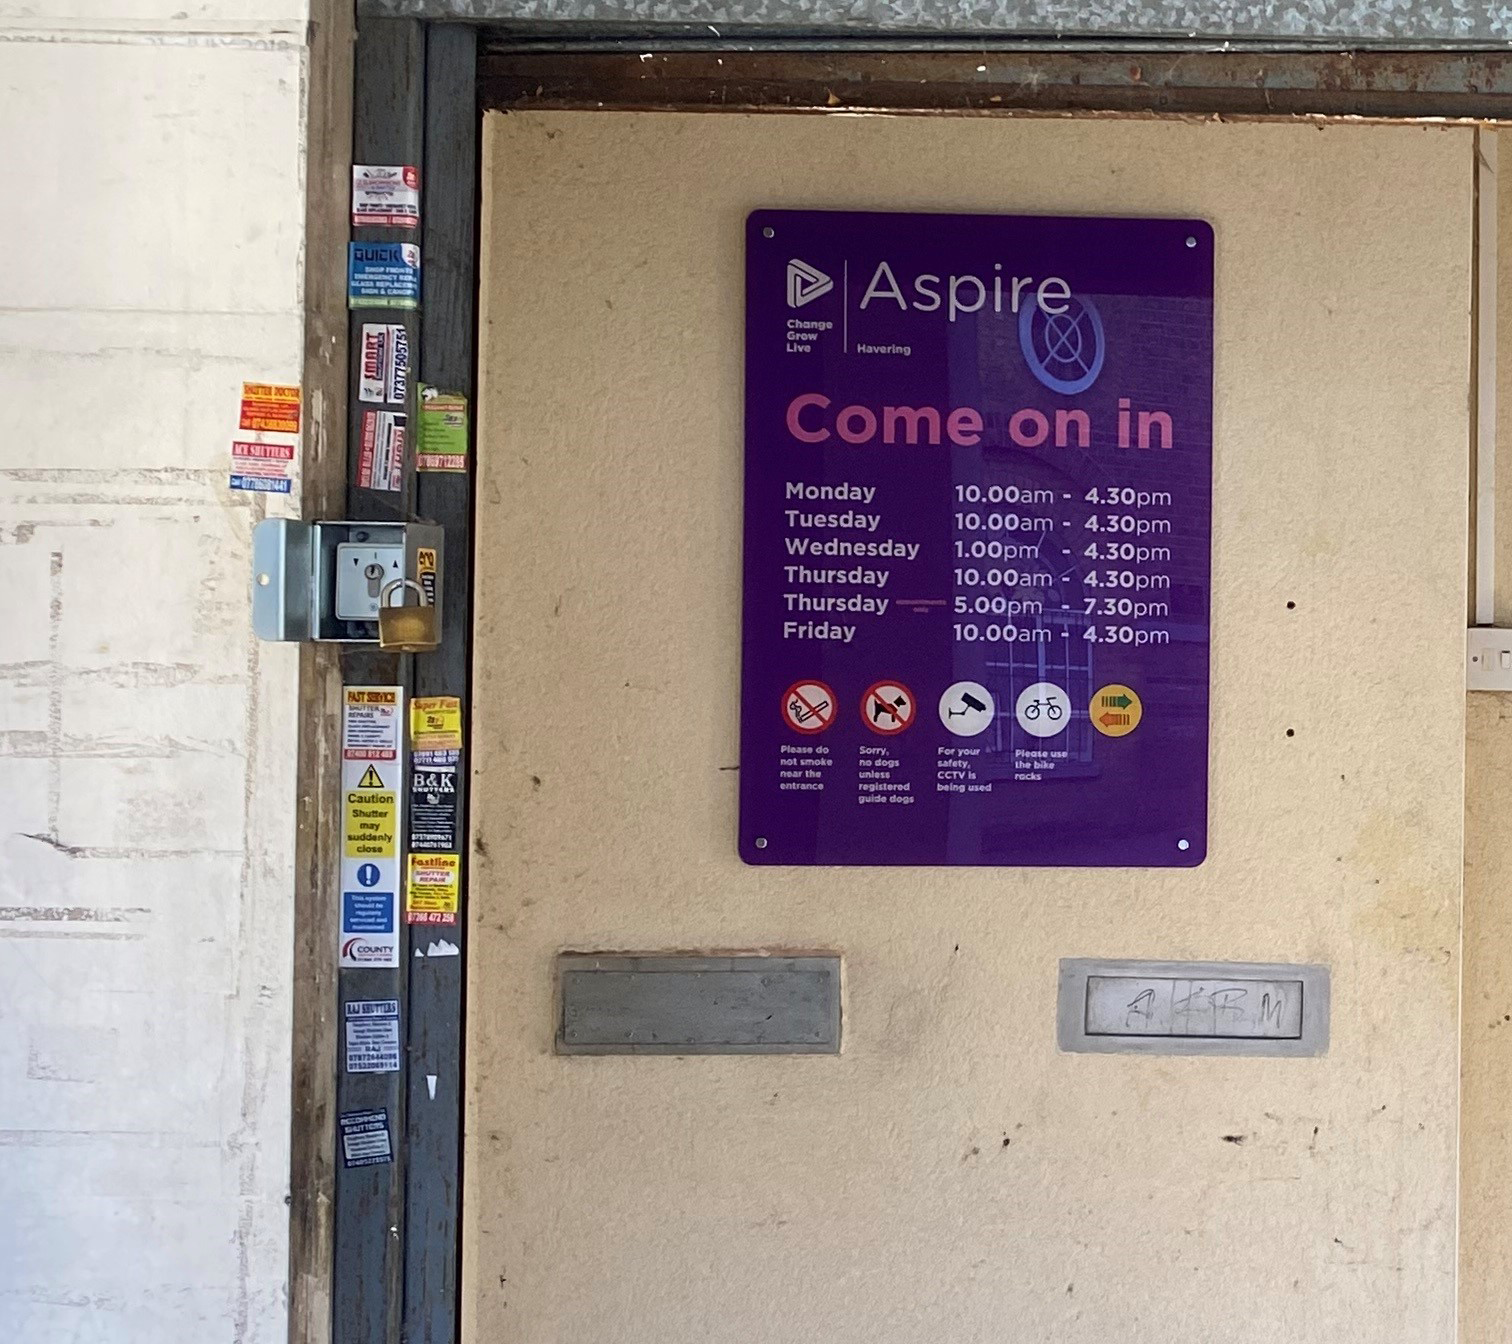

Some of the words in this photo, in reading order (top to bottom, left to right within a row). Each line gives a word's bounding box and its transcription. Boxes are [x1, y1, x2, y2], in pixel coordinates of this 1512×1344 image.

[354, 248, 400, 262] QUICK
[859, 261, 1071, 322] Aspire
[786, 319, 833, 331] Change
[786, 331, 818, 341] Grow
[786, 343, 811, 353] Live
[857, 344, 911, 356] Havering
[364, 332, 379, 380] SMART
[786, 393, 984, 446] Come
[1009, 408, 1090, 448] on
[1118, 398, 1173, 449] in
[250, 444, 290, 457] SHUTTERS
[785, 482, 876, 504] Monday
[955, 485, 1054, 504] 10.00am
[1084, 488, 1172, 507] 4.30pm
[785, 510, 880, 532] Tuesday
[955, 513, 1054, 532] 10.00am
[1084, 515, 1171, 536] 4.30pm
[785, 538, 920, 560] Wednesday
[954, 541, 1039, 561] 1.00pm
[1084, 543, 1171, 564] 4.30pm
[784, 566, 890, 588] Thursday
[954, 569, 1053, 588] 10.00am
[1083, 571, 1171, 591] 4.30pm
[783, 594, 890, 616] Thursday
[954, 596, 1043, 617] 5.00pm
[1083, 599, 1169, 619] 7.30pm
[783, 621, 856, 643] Friday
[953, 624, 1052, 643] 10.00am
[1082, 626, 1170, 647] 4.30pm
[348, 692, 366, 702] FAST
[367, 692, 395, 702] SERVICE
[414, 699, 437, 712] Super
[780, 745, 813, 754] Please
[815, 745, 830, 754] do
[859, 745, 890, 756] Sorry,
[937, 747, 955, 755] For
[957, 748, 981, 757] your
[1014, 749, 1048, 758] Please
[1050, 750, 1068, 758] use
[780, 757, 797, 766] not
[800, 757, 833, 766] smoke
[874, 758, 900, 768] dogs
[937, 758, 971, 769] safety,
[1014, 760, 1031, 769] the
[1033, 760, 1056, 769] bike
[780, 770, 803, 778] near
[805, 769, 822, 778] the
[859, 770, 891, 779] unless
[937, 771, 966, 779] CCTV
[968, 771, 977, 779] is
[1014, 772, 1042, 780] racks
[780, 782, 824, 790] entrance
[858, 782, 911, 792] registered
[937, 782, 966, 793] being
[967, 783, 992, 792] used
[348, 793, 394, 803] Caution
[858, 794, 887, 804] guide
[889, 794, 915, 804] dogs
[352, 809, 388, 817] Shutter
[360, 823, 380, 831] may
[347, 833, 392, 843] suddenly
[356, 845, 383, 853] close
[411, 857, 456, 867] Fastline
[347, 1004, 360, 1014] RAJ
[362, 1002, 396, 1013] SHUTTERS
